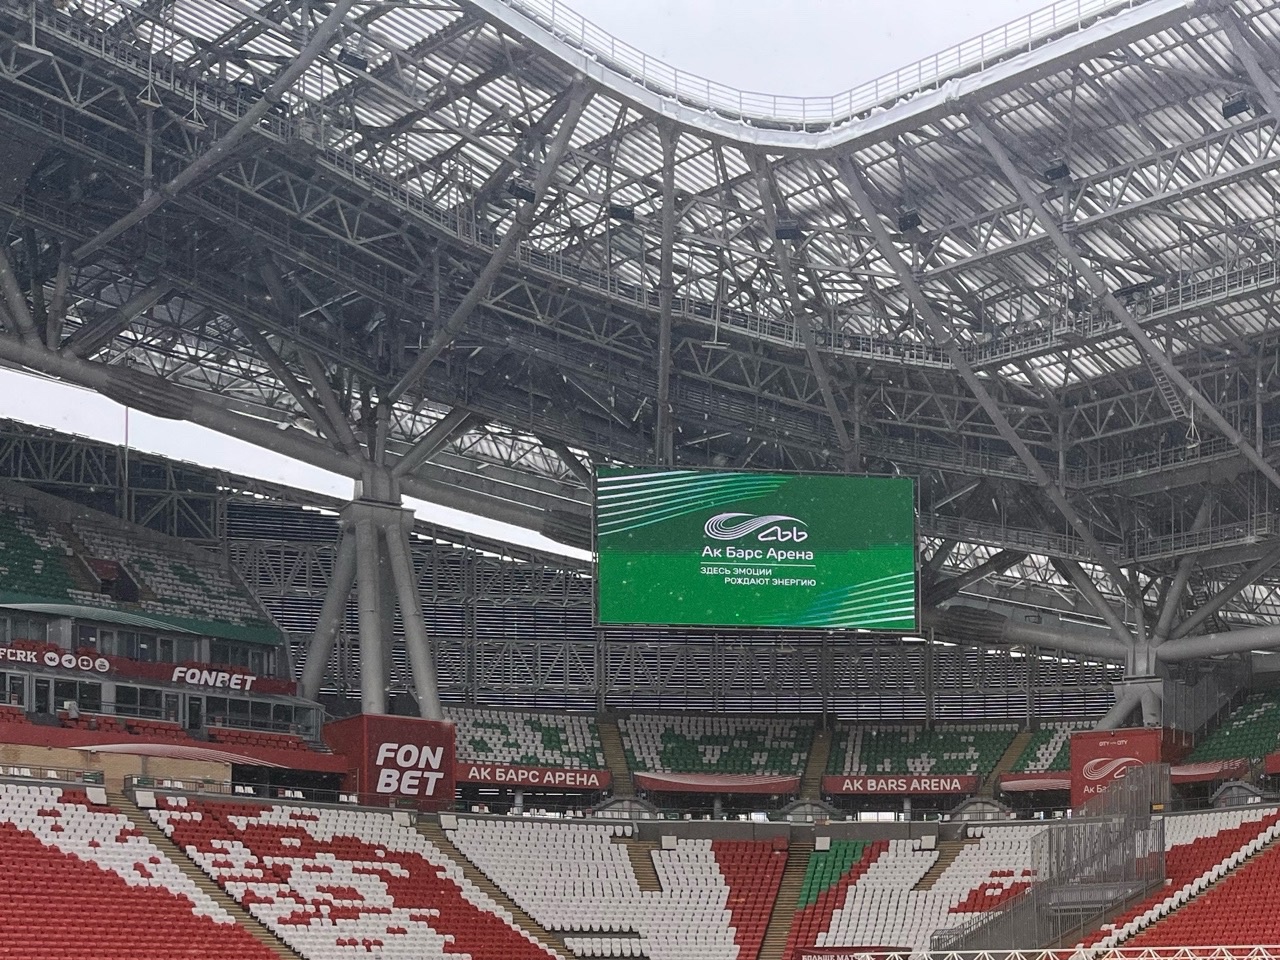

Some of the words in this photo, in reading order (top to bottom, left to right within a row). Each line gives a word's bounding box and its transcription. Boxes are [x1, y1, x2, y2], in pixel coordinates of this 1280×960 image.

[702, 546, 722, 557] Ак
[726, 546, 763, 560] Барс
[766, 547, 814, 561] Арена
[700, 567, 731, 575] ЗДЕСЬ
[733, 567, 772, 576] ЭМОЦИИ
[724, 577, 770, 585] РОЖДАЮТ
[772, 578, 817, 586] ЭНЕРГИЮ
[172, 666, 256, 691] FONBET
[375, 742, 444, 769] FON
[376, 768, 444, 796] BET
[468, 766, 491, 780] АК
[495, 768, 540, 783] БАРС
[543, 771, 599, 786] АРЕНА
[842, 779, 863, 791] AK
[867, 778, 907, 791] BARS
[910, 778, 961, 791] ARENA
[1083, 785, 1095, 793] Ак
